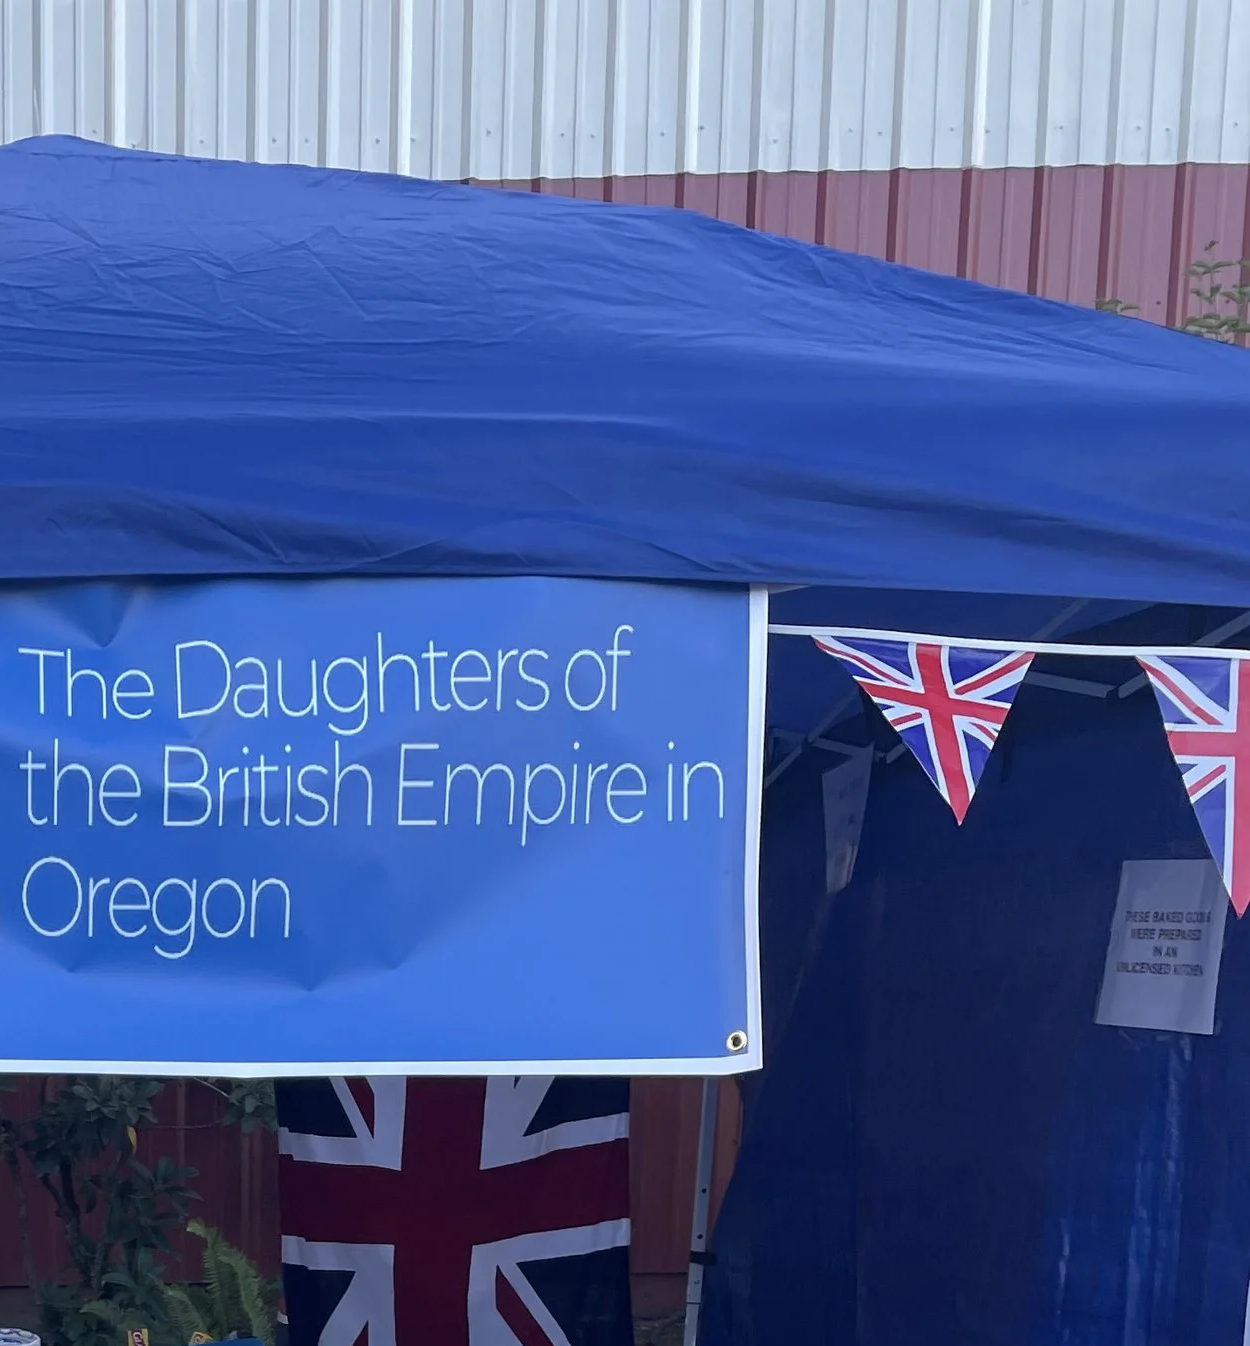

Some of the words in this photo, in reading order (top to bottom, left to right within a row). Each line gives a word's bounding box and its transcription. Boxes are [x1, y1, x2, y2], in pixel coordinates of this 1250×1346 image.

[18, 647, 155, 720] The
[175, 632, 550, 736] Daughters
[563, 624, 634, 712] of
[19, 738, 142, 826] the
[163, 740, 373, 827] British
[397, 741, 647, 847] Empire
[666, 741, 724, 822] in
[22, 856, 291, 959] Oregon
